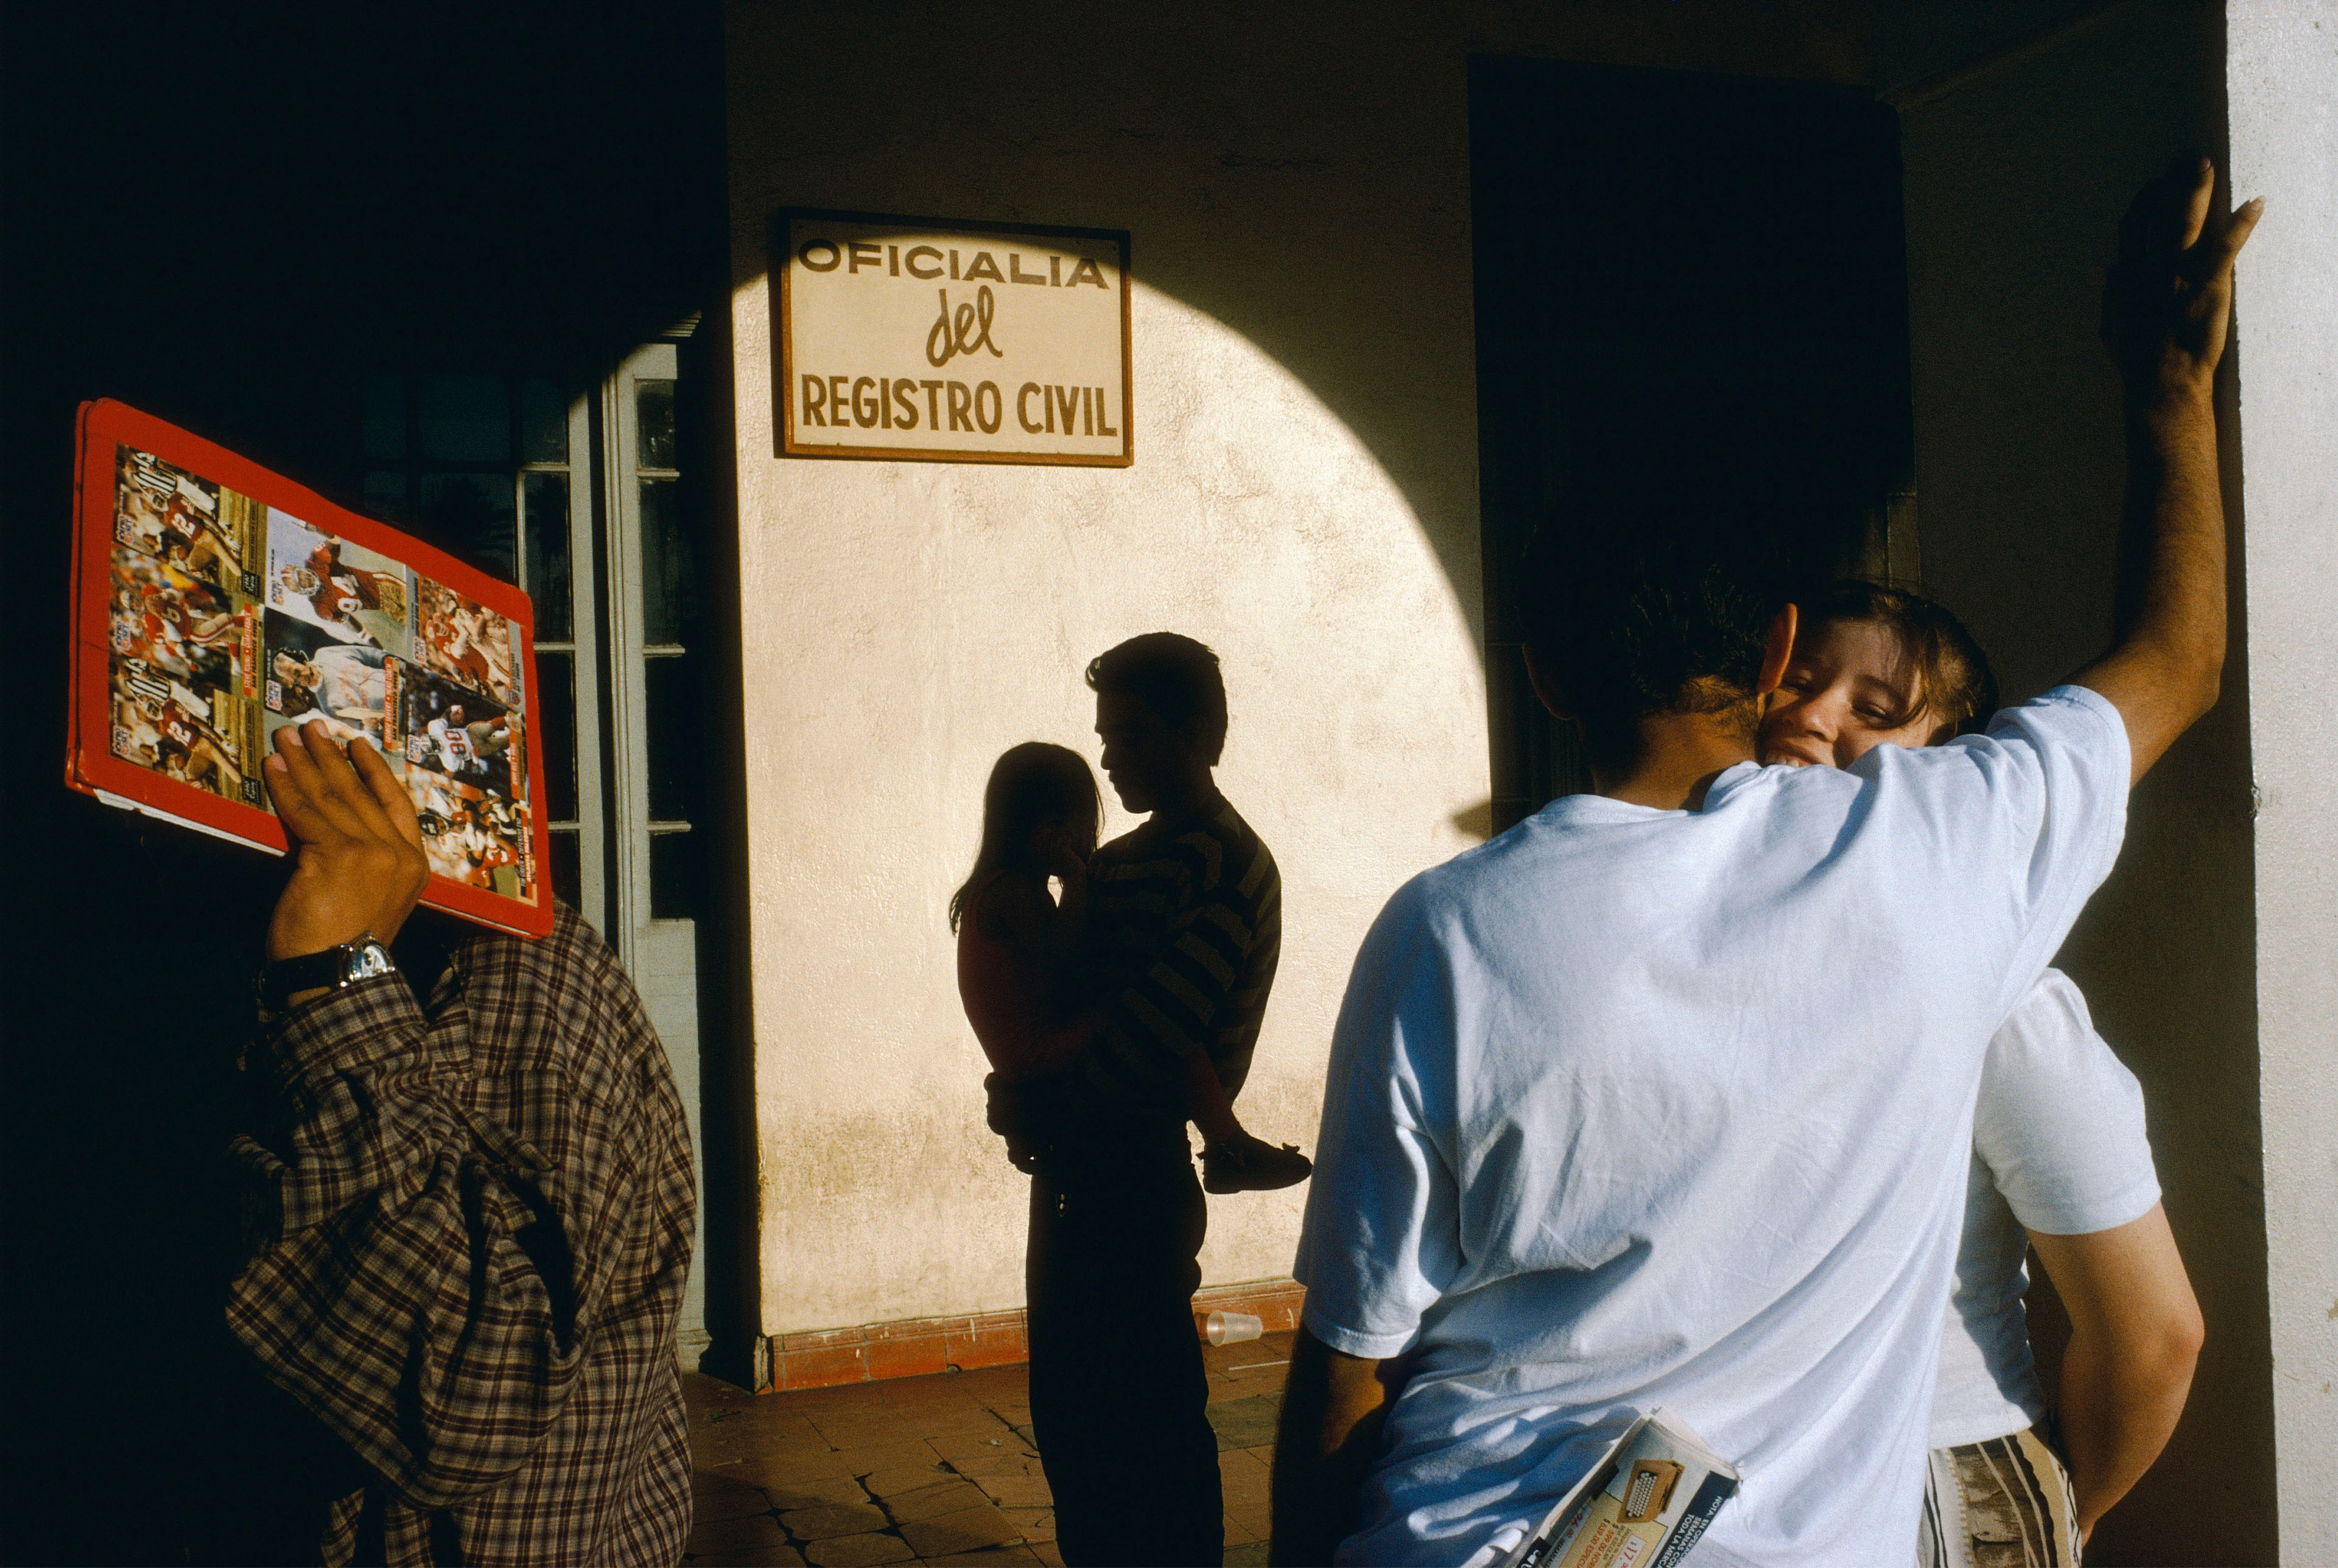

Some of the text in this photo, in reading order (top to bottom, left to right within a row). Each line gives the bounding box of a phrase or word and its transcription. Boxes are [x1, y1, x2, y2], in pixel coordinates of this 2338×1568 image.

[798, 238, 1111, 290] OFICIALIA
[925, 285, 1003, 368] del
[801, 374, 1118, 437] REGISTRO CIVIL
[444, 730, 467, 755] 80
[1706, 1496, 1723, 1517] NOTA:
[1677, 1514, 1694, 1533] TODA
[1677, 1517, 1701, 1550] SEMANAS
[1699, 1519, 1708, 1530] EN
[1671, 1535, 1681, 1544] LA
